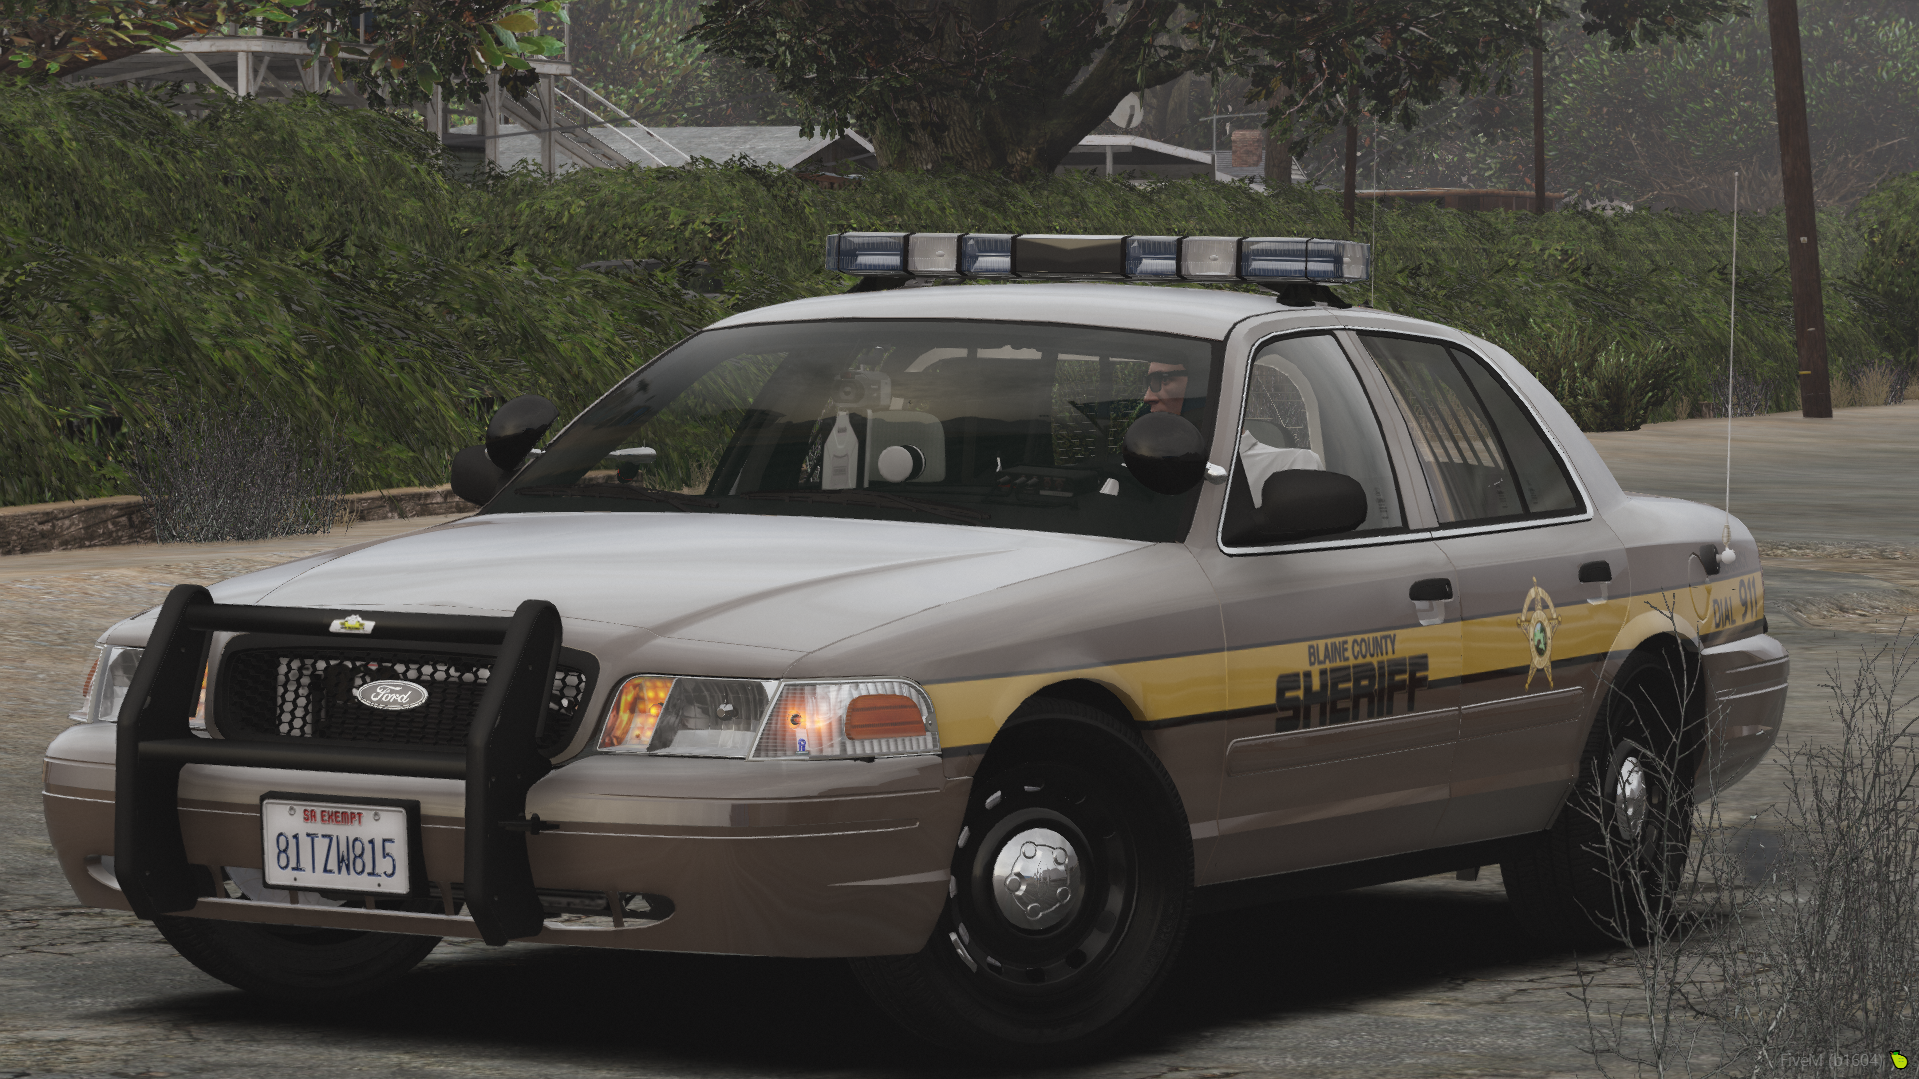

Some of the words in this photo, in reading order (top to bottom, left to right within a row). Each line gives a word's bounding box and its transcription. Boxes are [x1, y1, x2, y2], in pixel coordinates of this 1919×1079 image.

[1712, 596, 1736, 629] DIAL
[1739, 575, 1758, 622] 911
[1308, 640, 1350, 667] BLAINE
[1351, 633, 1397, 661] COUNTY
[370, 685, 412, 703] Ford
[1275, 653, 1429, 733] SHERIFF
[303, 808, 317, 823] SA
[320, 809, 364, 826] EXEMPT
[276, 832, 397, 878] 81TZW815
